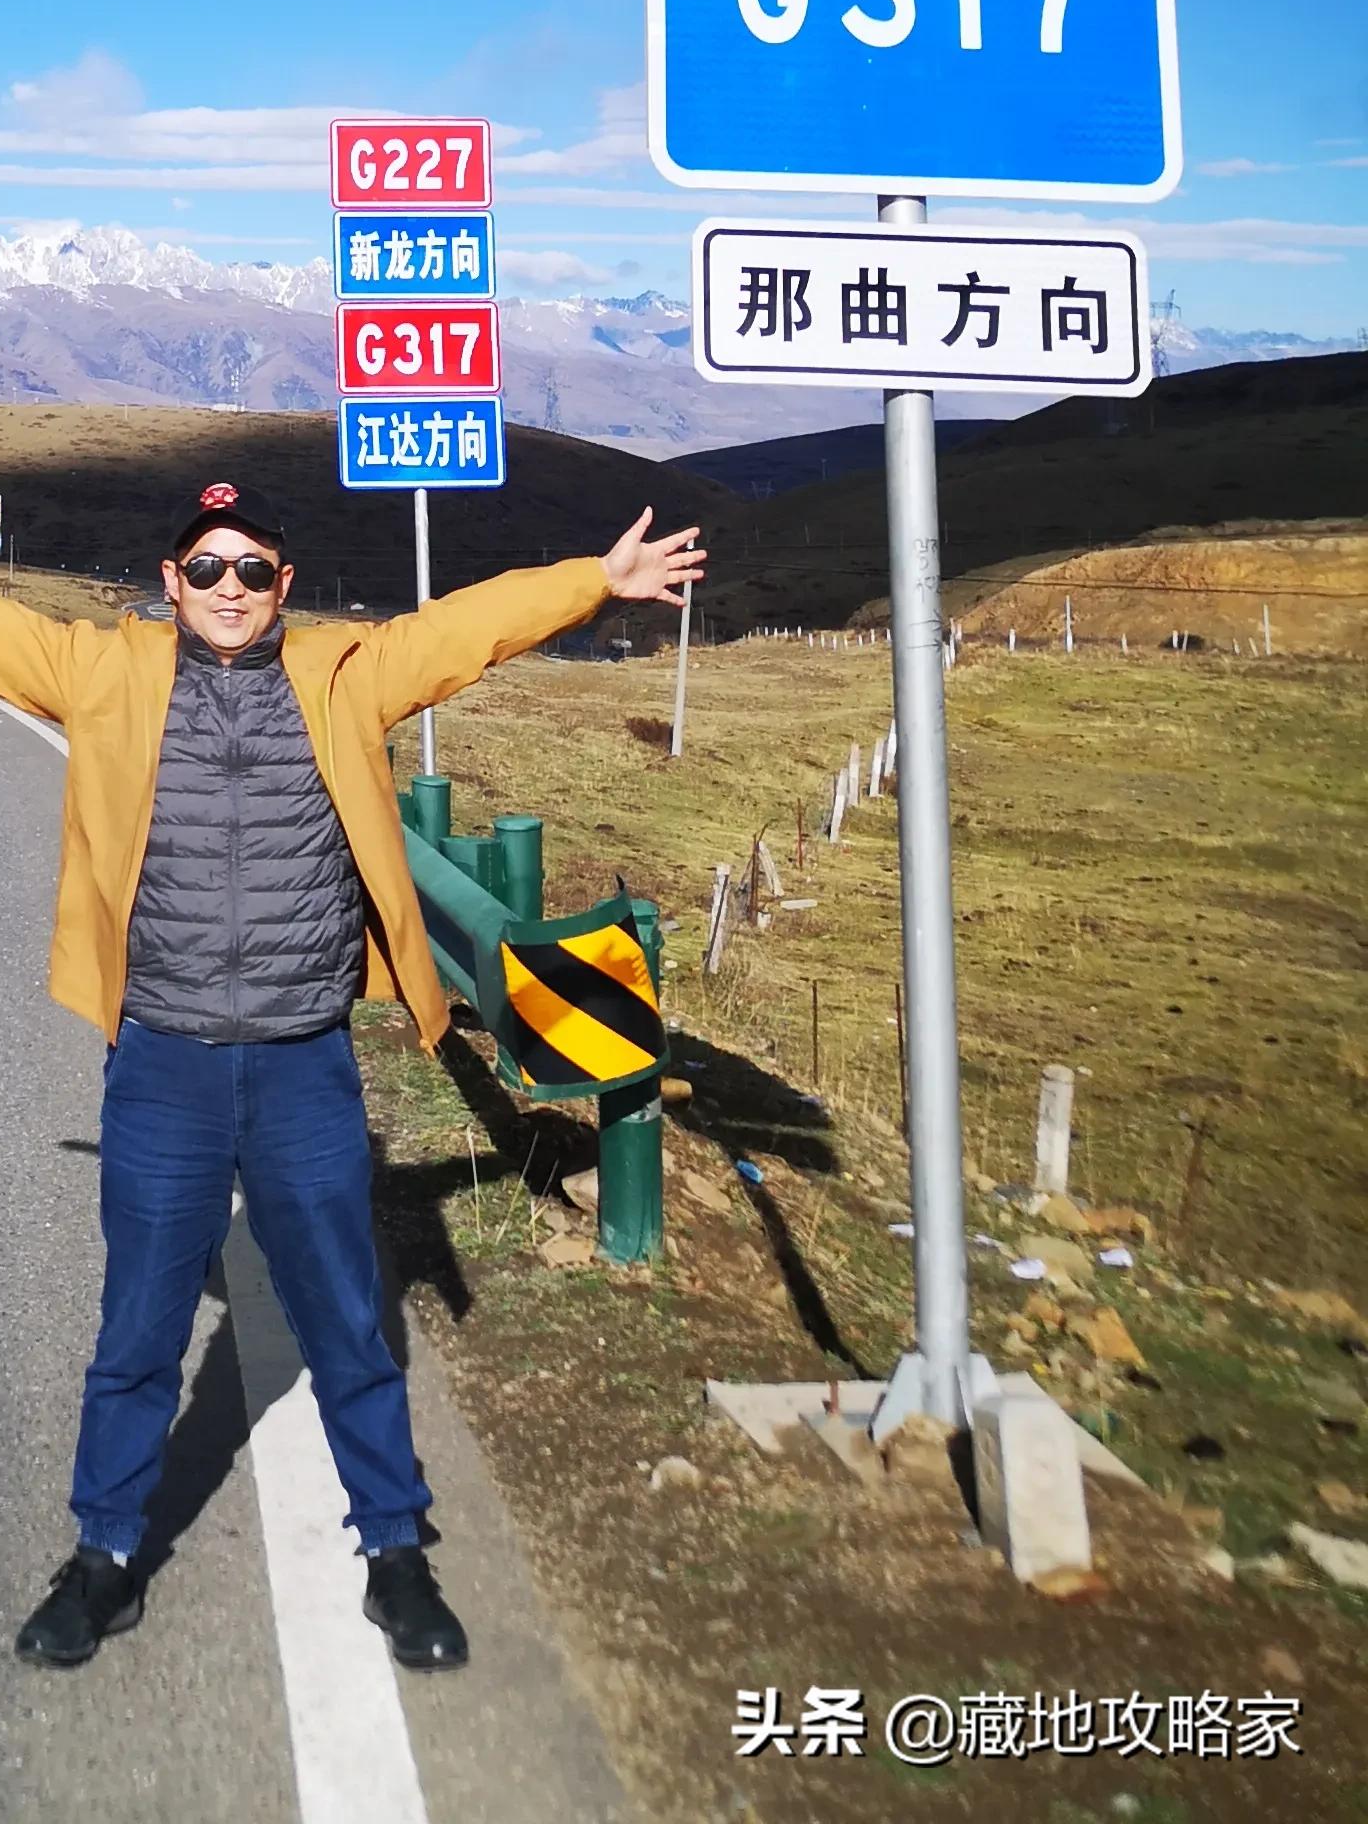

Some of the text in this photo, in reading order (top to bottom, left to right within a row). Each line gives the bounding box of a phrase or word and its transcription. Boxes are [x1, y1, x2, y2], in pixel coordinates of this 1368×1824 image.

[349, 137, 473, 190] G227
[349, 229, 480, 281] 新龙方向
[735, 265, 1111, 355] 那曲方向
[356, 322, 481, 375] G317
[357, 410, 487, 468] 江达方向
